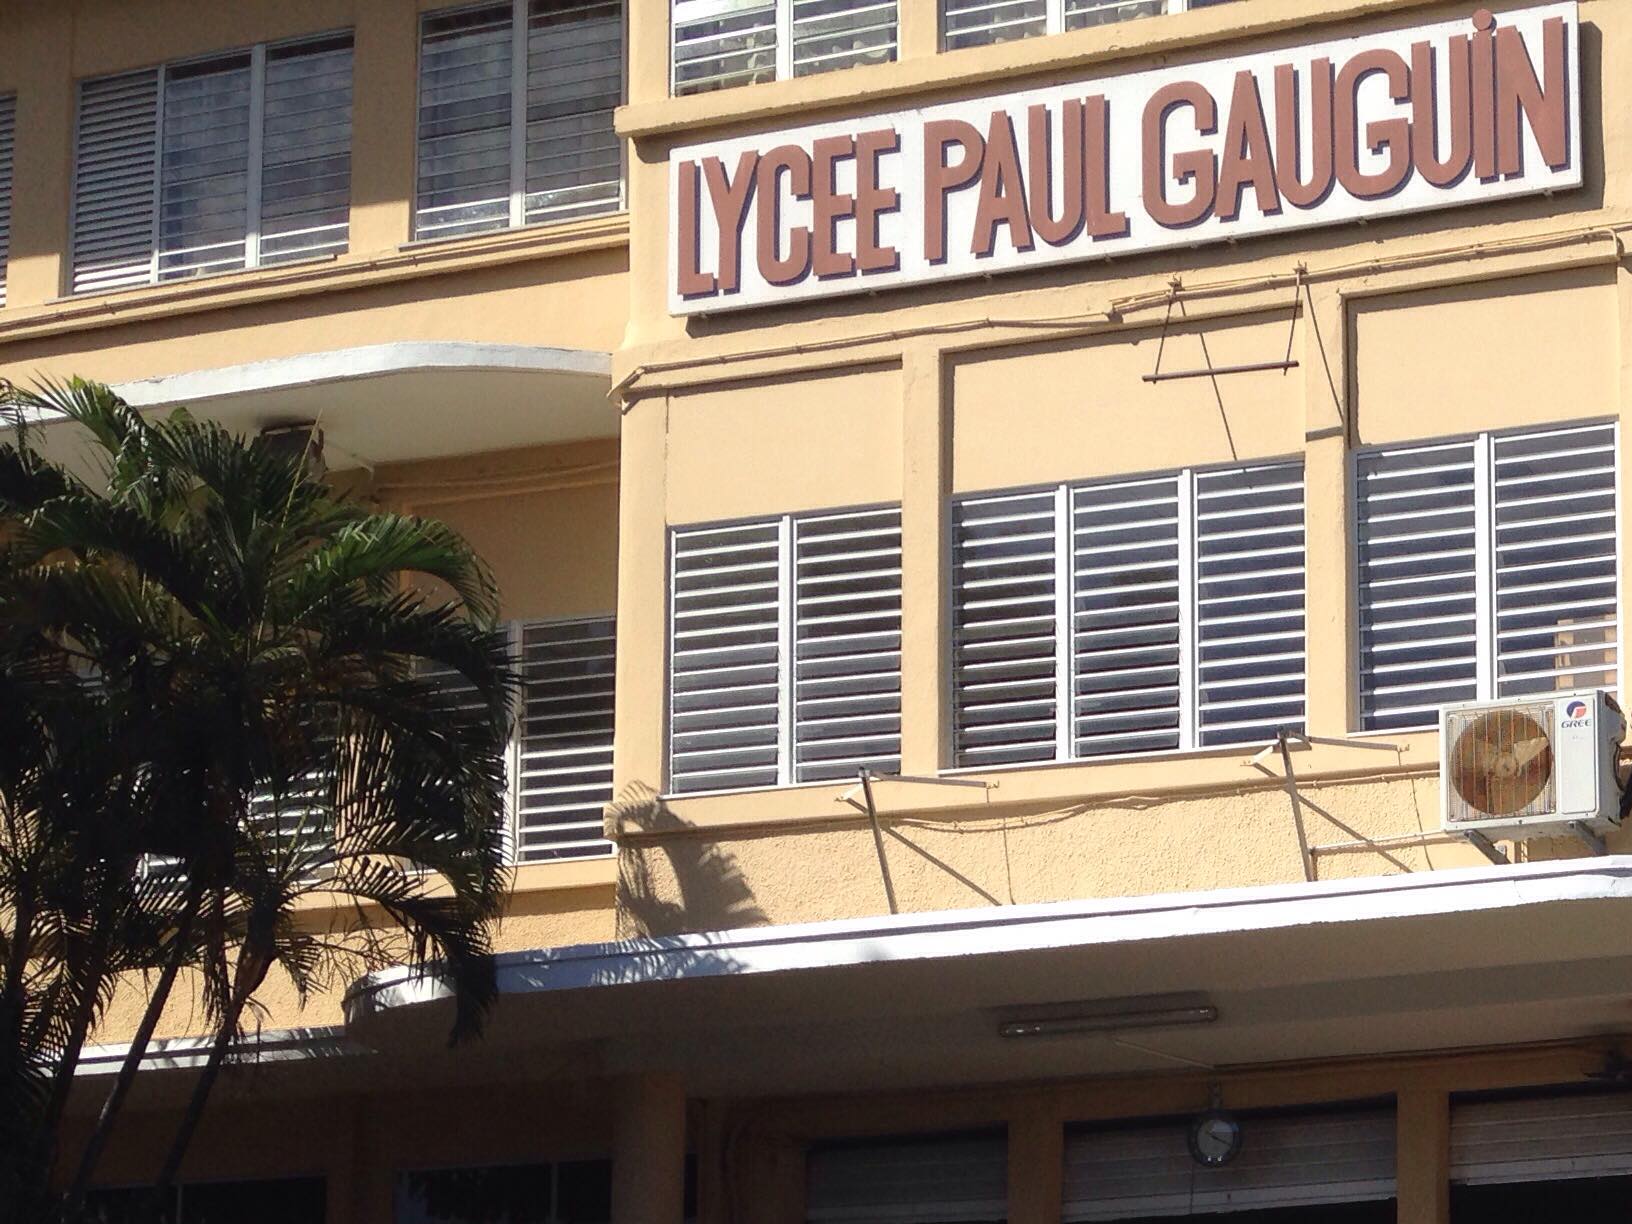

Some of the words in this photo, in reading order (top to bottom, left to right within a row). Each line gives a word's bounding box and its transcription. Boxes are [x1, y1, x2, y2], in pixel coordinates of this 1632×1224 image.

[677, 127, 901, 299] LYCEE
[922, 94, 1131, 264] PAUL
[1561, 719, 1592, 728] GREE
